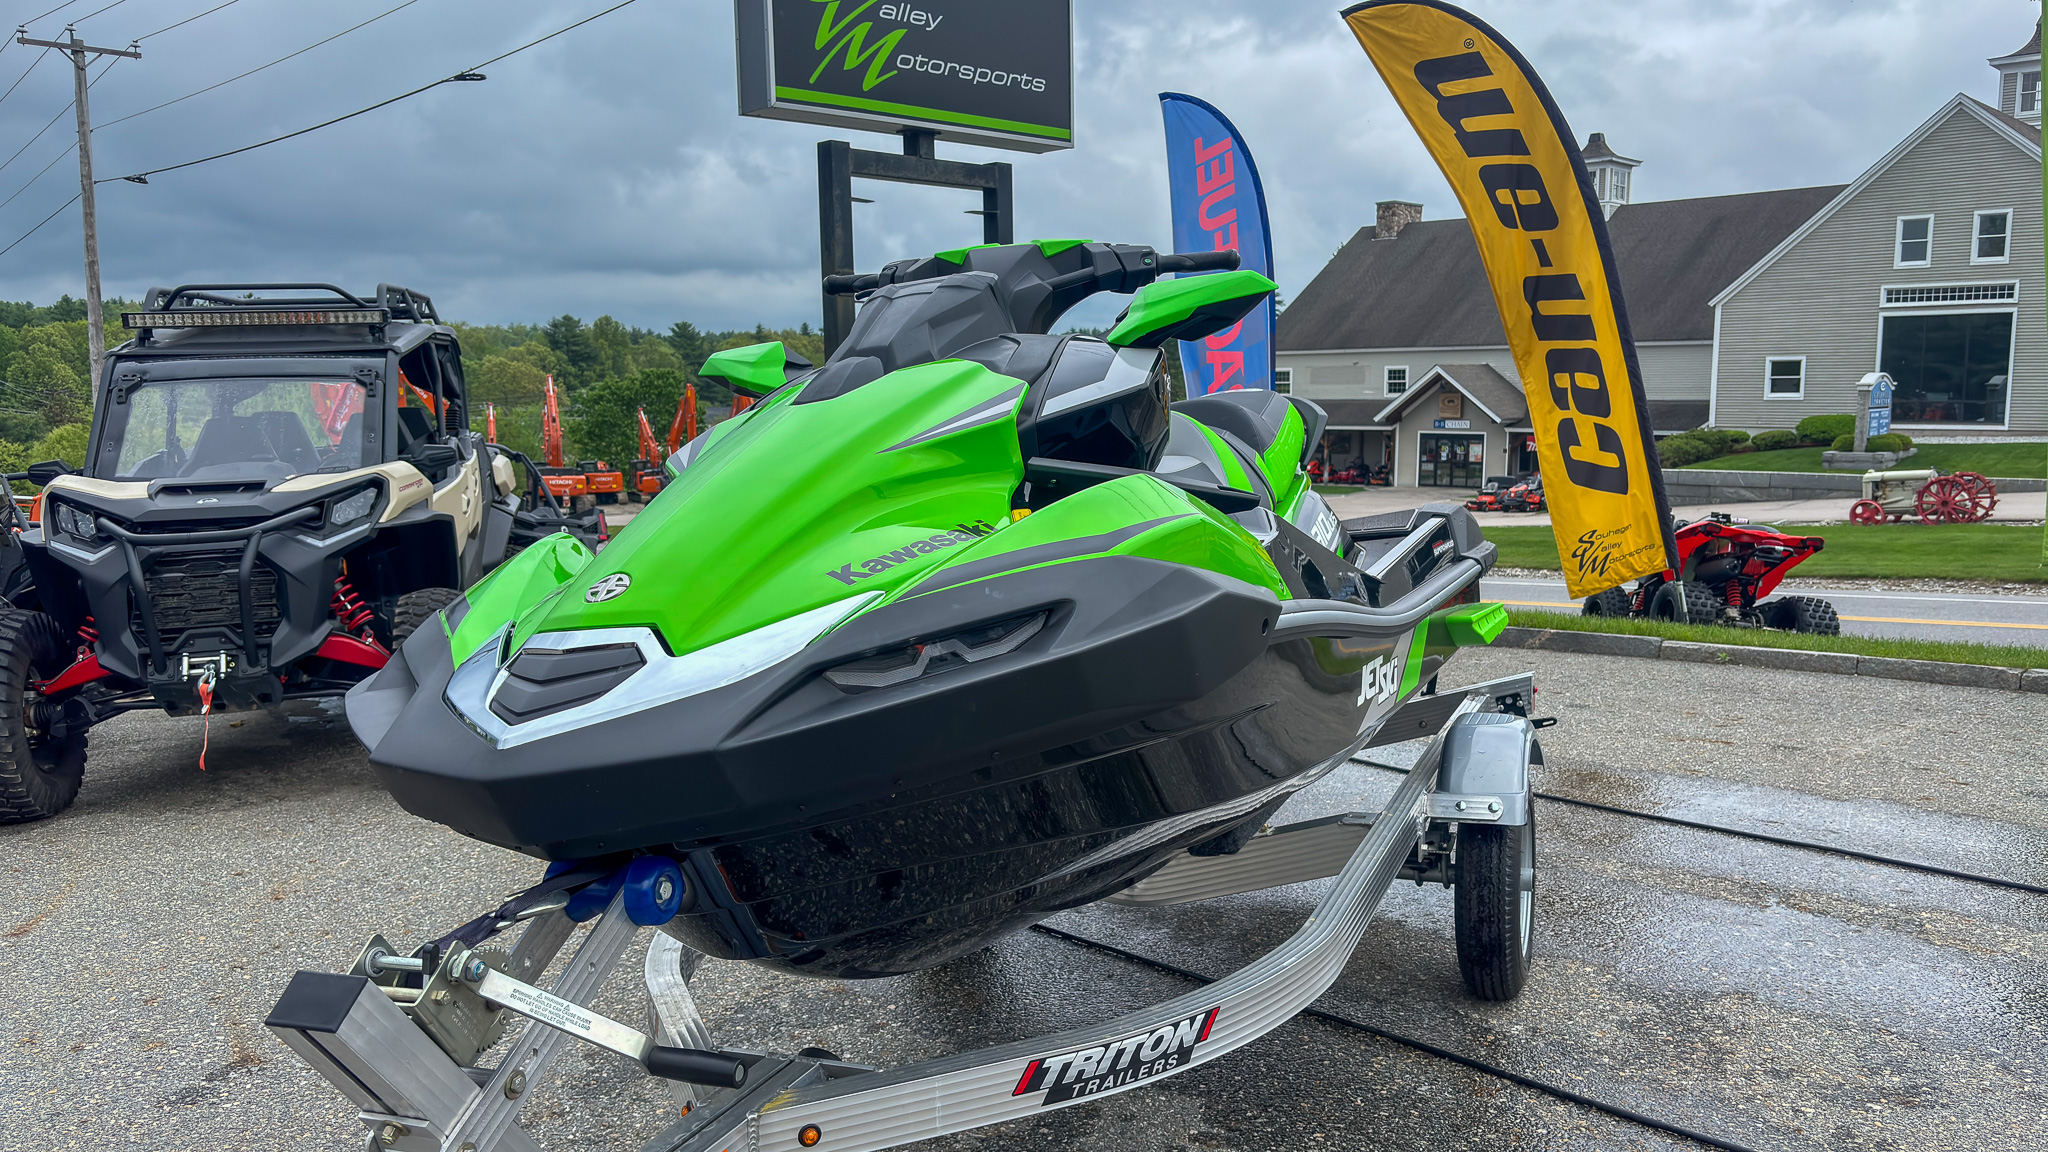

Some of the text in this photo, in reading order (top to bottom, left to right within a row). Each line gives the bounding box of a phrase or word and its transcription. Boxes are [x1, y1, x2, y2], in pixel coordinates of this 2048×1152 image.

[808, 21, 1046, 92] Motorsports
[1414, 50, 1629, 496] can-am
[825, 520, 999, 586] Kawasaki
[1572, 524, 1632, 558] Souhegan
[547, 1014, 556, 1023] LET
[561, 1009, 577, 1019] CAUSE
[578, 1021, 591, 1031] LOAD
[1040, 1012, 1206, 1090] TRITON
[1071, 1054, 1179, 1098] TRAILERS
